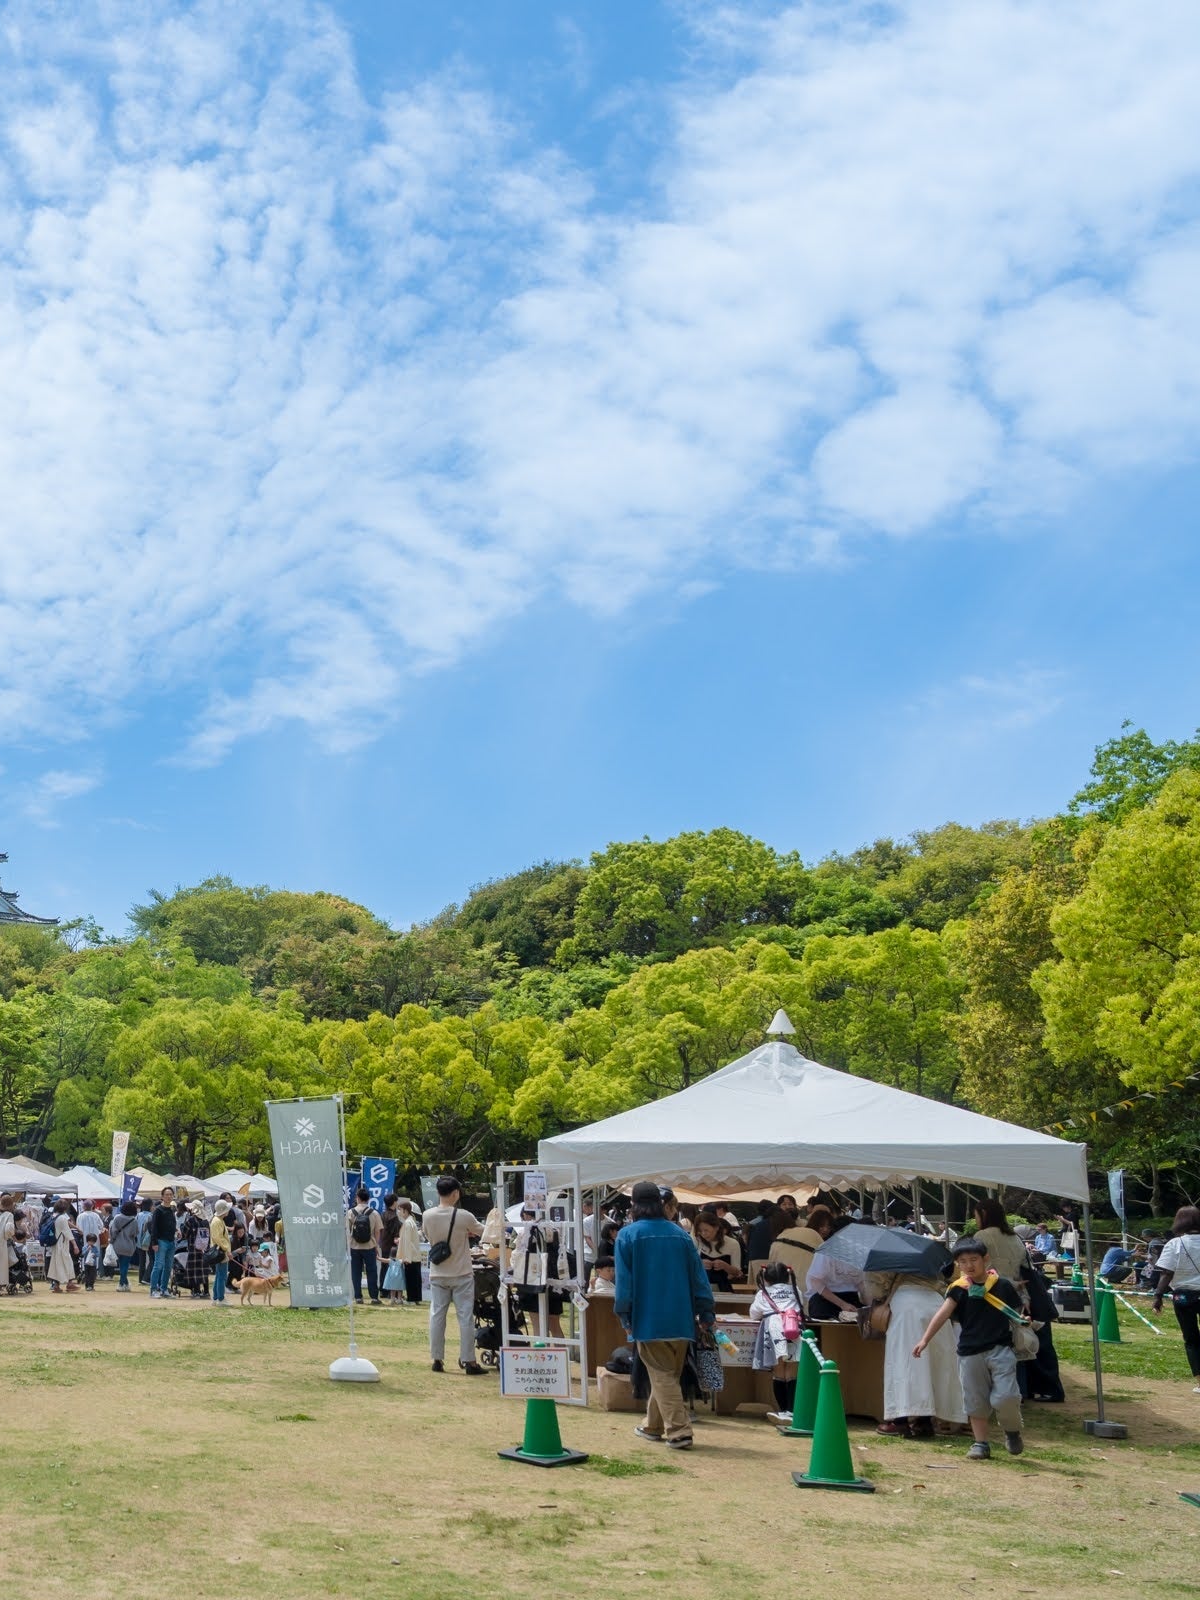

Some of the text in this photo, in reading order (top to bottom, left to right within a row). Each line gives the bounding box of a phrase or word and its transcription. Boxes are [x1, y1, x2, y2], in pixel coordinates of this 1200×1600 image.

[512, 1353, 559, 1362] ワーククラフト
[514, 1367, 558, 1375] 予約済みの方は
